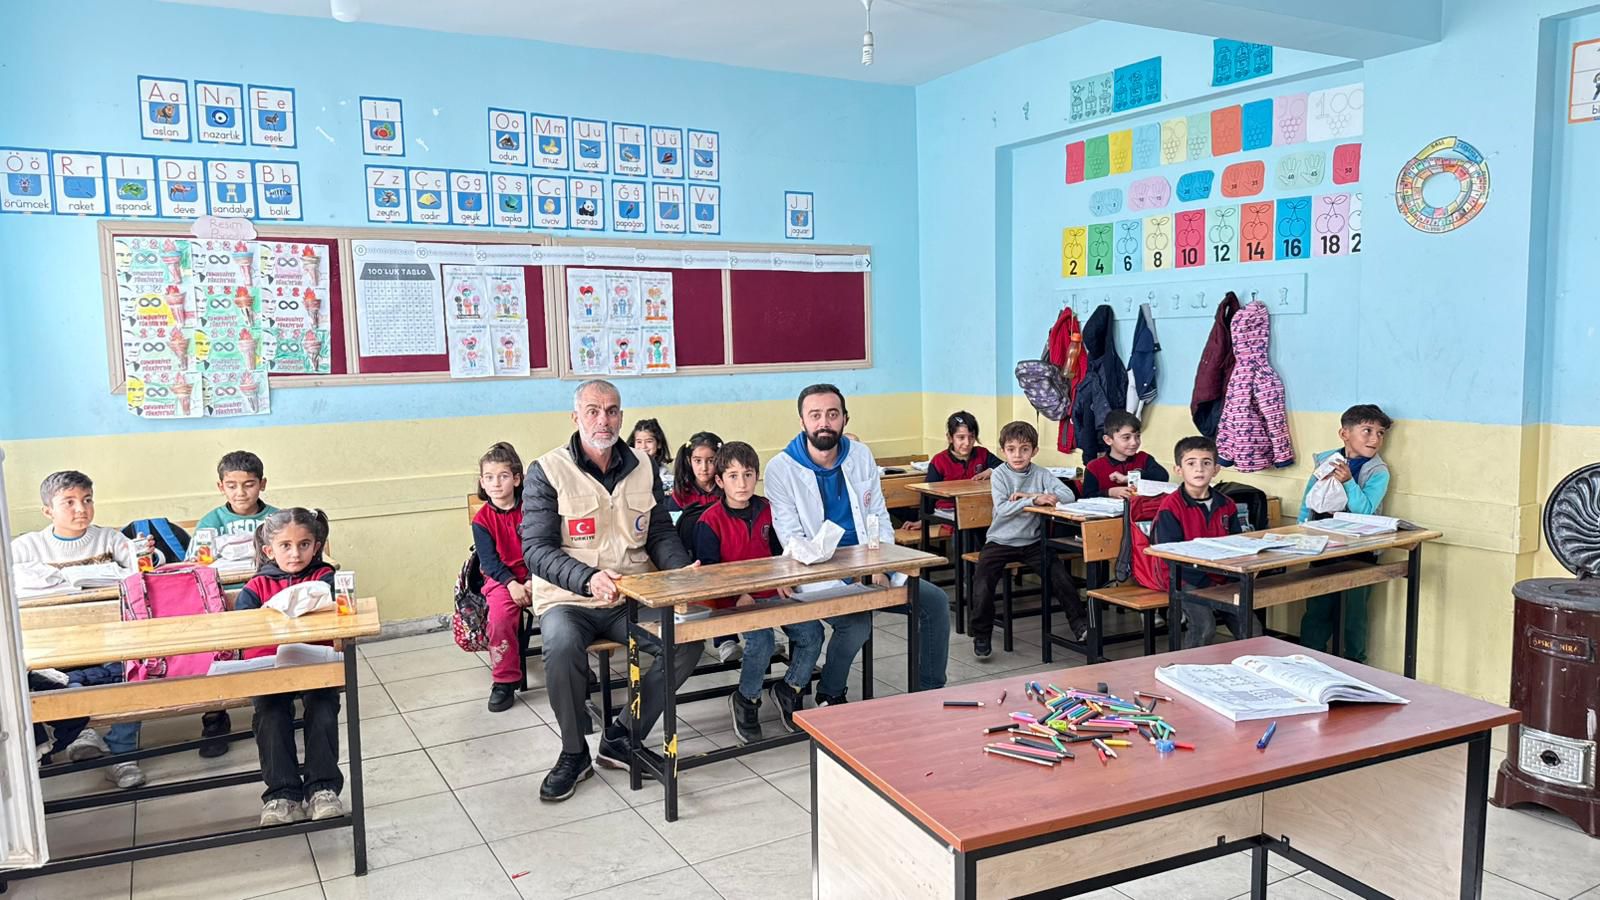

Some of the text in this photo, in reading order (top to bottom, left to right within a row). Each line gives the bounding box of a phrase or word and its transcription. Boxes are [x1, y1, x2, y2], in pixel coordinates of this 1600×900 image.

[152, 126, 179, 137] aslan
[375, 144, 393, 152] incir
[499, 152, 518, 161] odun
[4, 199, 49, 209] örümcek
[69, 200, 94, 210] raket
[173, 204, 195, 214] deve
[213, 205, 253, 217] sandalye
[376, 208, 400, 219] zeytin
[576, 217, 598, 228] panda
[1283, 238, 1302, 257] 16
[1320, 234, 1340, 254] 18
[1181, 247, 1198, 265] 10
[1213, 244, 1230, 262] 12
[1246, 241, 1265, 260] 14
[1095, 258, 1104, 273] 4
[1123, 255, 1132, 271] 6
[1153, 251, 1162, 268] 8
[401, 268, 427, 276] TABLO
[1069, 260, 1077, 275] 2
